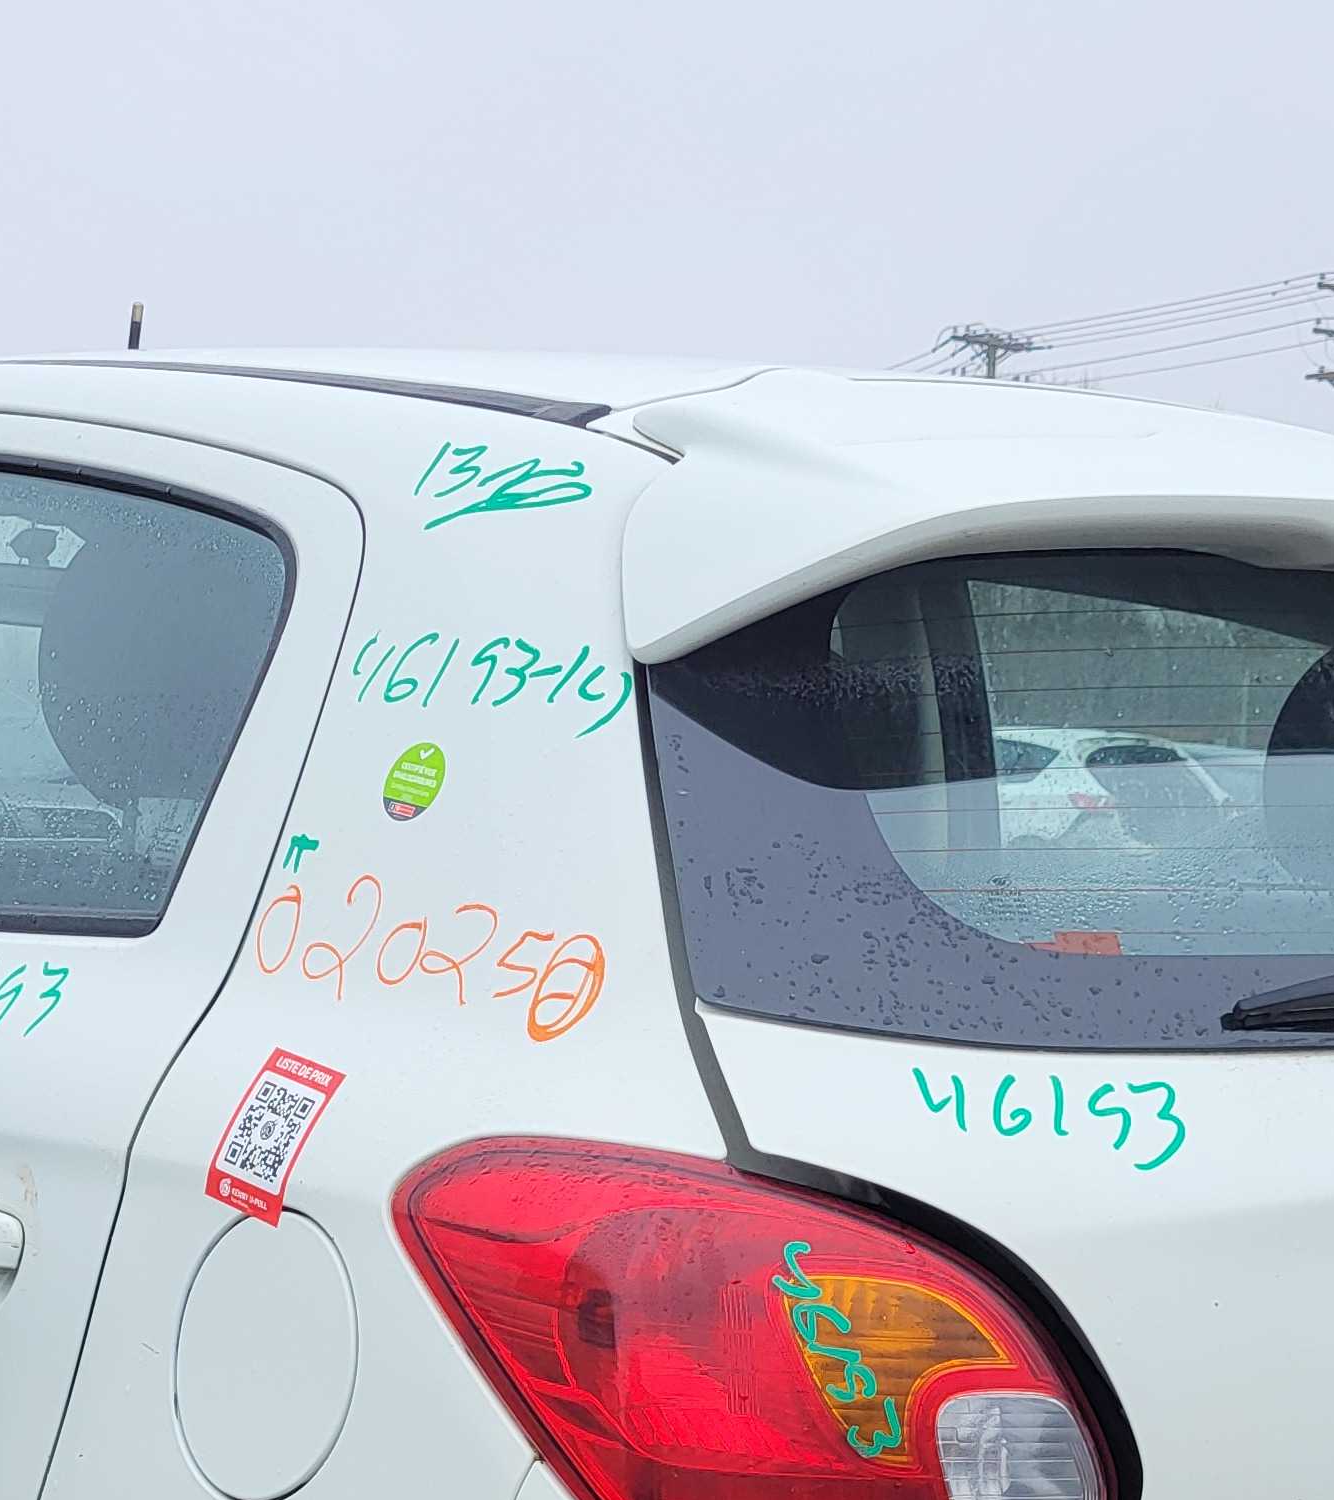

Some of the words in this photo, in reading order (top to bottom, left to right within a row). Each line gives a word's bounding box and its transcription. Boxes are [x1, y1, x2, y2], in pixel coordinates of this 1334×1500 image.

[276, 1056, 302, 1074] LISTE
[298, 1065, 314, 1078] DE
[309, 1070, 334, 1087] PRIX
[913, 1067, 1186, 1171] 46193
